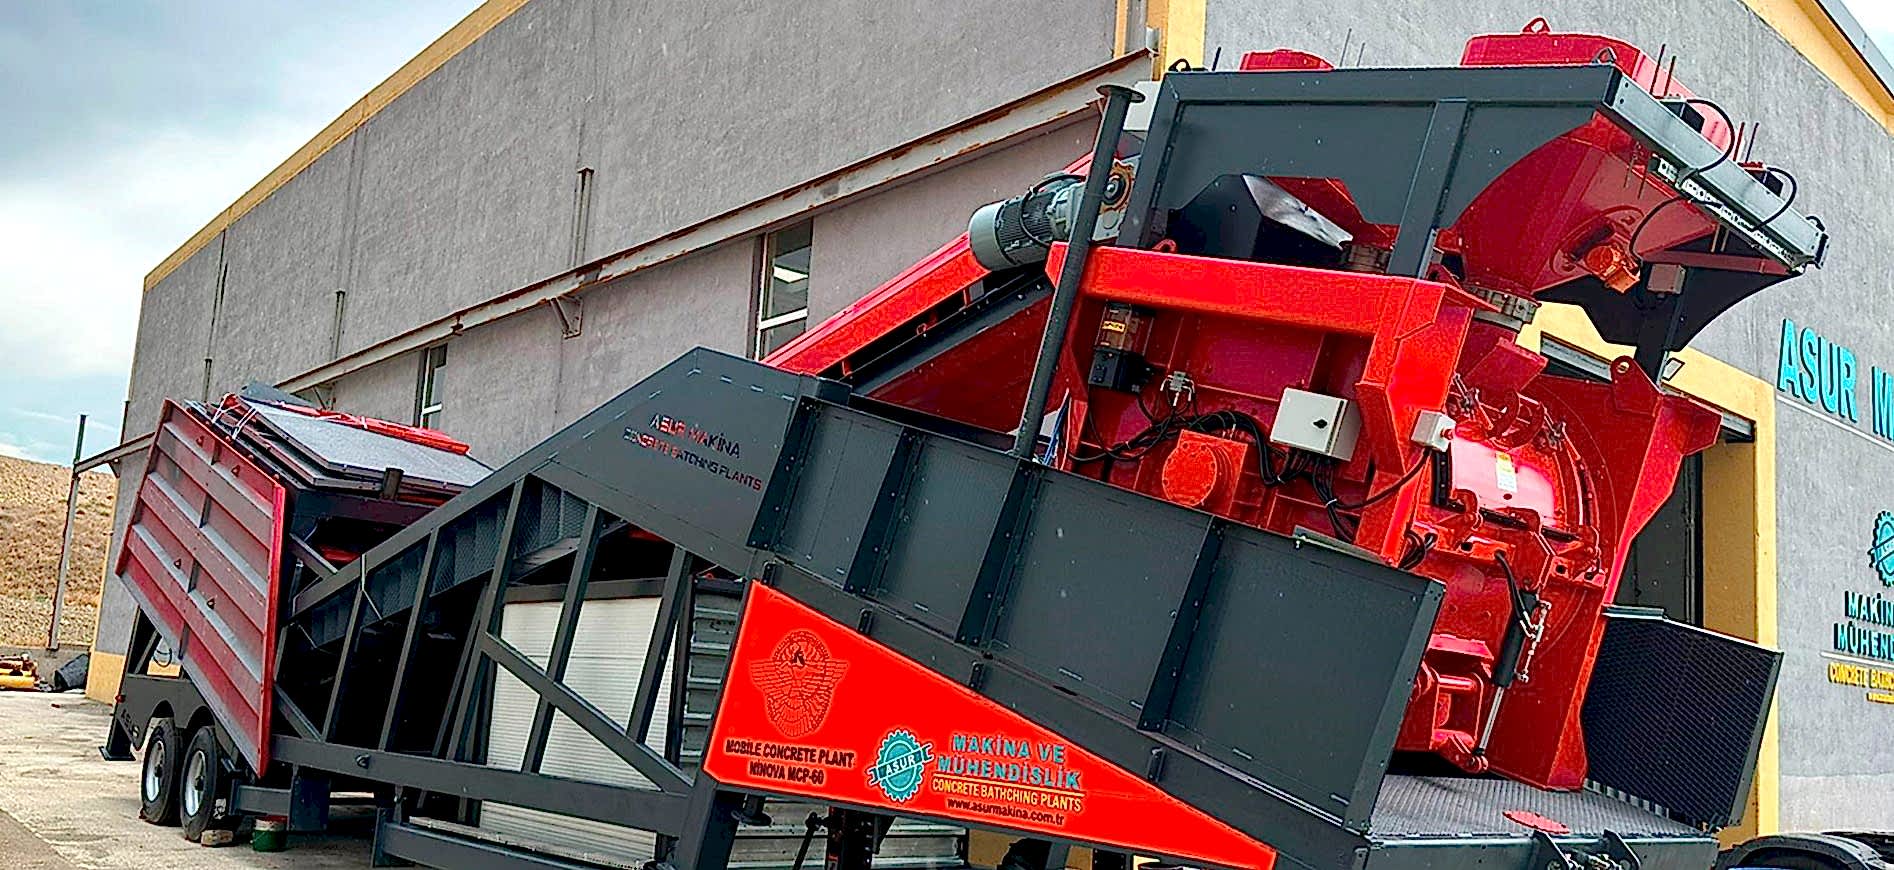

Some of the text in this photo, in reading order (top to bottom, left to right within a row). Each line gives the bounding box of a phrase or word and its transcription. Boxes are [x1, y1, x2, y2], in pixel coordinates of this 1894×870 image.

[1777, 318, 1857, 423] ASUR
[649, 412, 740, 459] ASUR MAKİNA
[719, 465, 763, 491] PLANTS
[762, 743, 817, 763] CONCRETE
[817, 749, 855, 768] PLANT
[952, 734, 1065, 763] MAKİNA VE
[787, 766, 825, 785] MCP-60
[885, 754, 916, 776] ASUR
[937, 755, 1081, 790] MÜHENDİSLİK
[932, 777, 1083, 813] CONCRETE BATHCHING PLANTS
[947, 797, 1065, 826] www.asurmakina.com.tr
